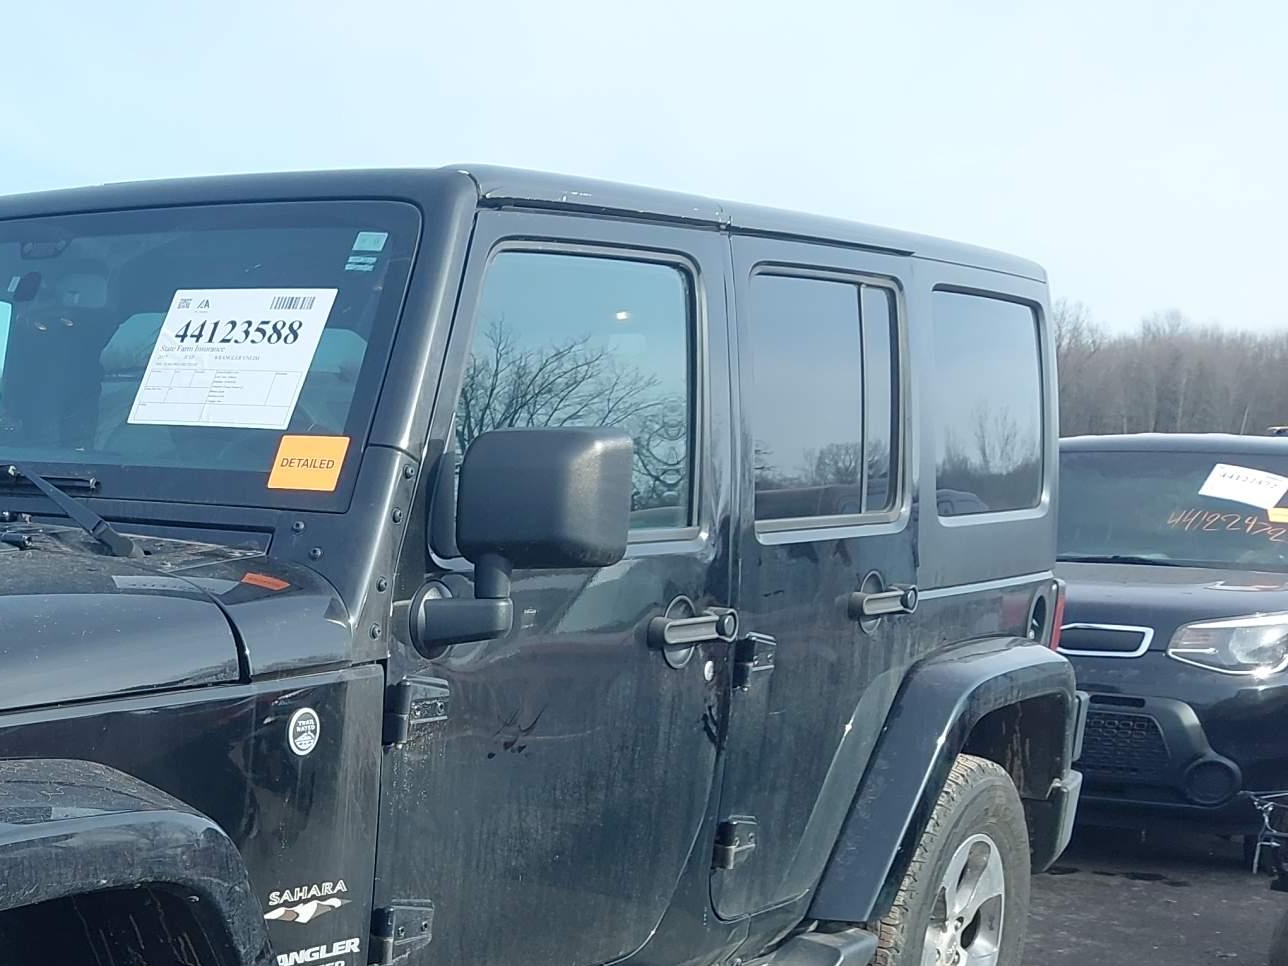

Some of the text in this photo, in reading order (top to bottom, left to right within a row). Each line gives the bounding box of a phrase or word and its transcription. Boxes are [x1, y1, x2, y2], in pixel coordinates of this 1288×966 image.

[175, 319, 304, 345] 44123588
[280, 457, 335, 470] DETAILED
[268, 879, 348, 906] SAHARA
